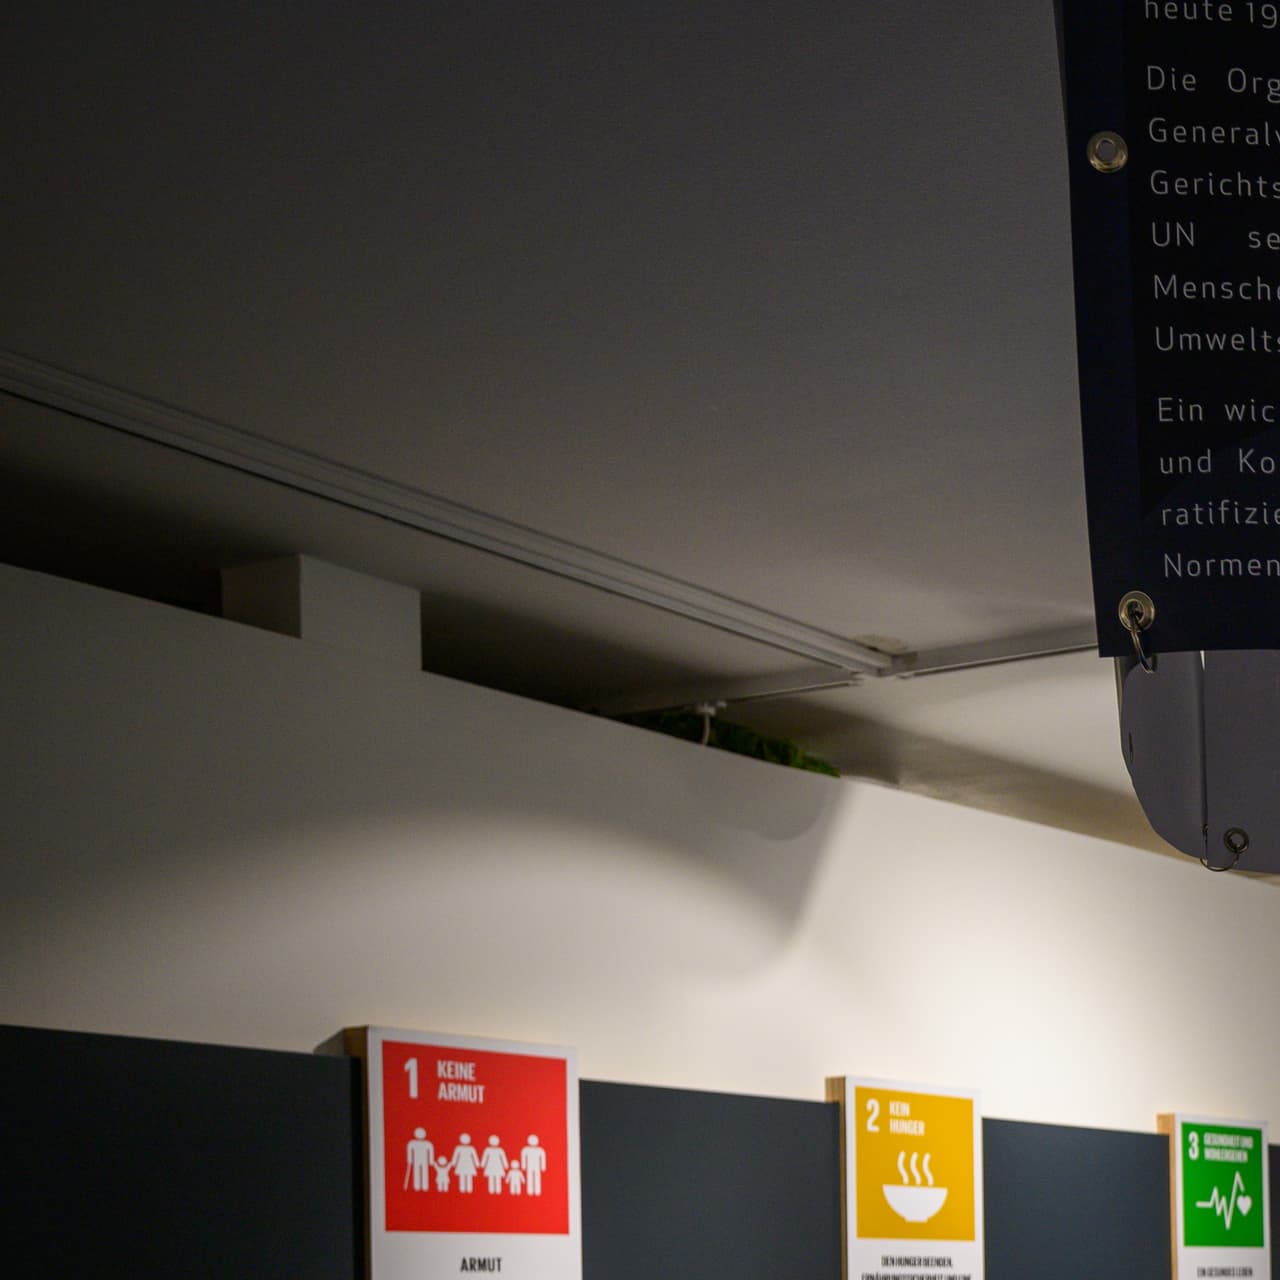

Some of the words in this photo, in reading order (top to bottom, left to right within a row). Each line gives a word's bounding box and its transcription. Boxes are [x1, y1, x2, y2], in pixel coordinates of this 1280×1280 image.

[1144, 0, 1233, 22] heute
[1146, 64, 1197, 92] Die
[1151, 221, 1195, 248] UN
[1157, 396, 1204, 423] Ein
[1159, 447, 1212, 475] und
[1163, 552, 1280, 579] Normen
[404, 1057, 419, 1099] 1
[437, 1059, 476, 1082] KEINE
[437, 1081, 485, 1104] ARMUT
[866, 1098, 880, 1132] 2
[889, 1100, 911, 1117] KEIN
[889, 1117, 925, 1137] HUNGER
[1188, 1131, 1199, 1162] 3
[460, 1256, 502, 1273] ARMUT
